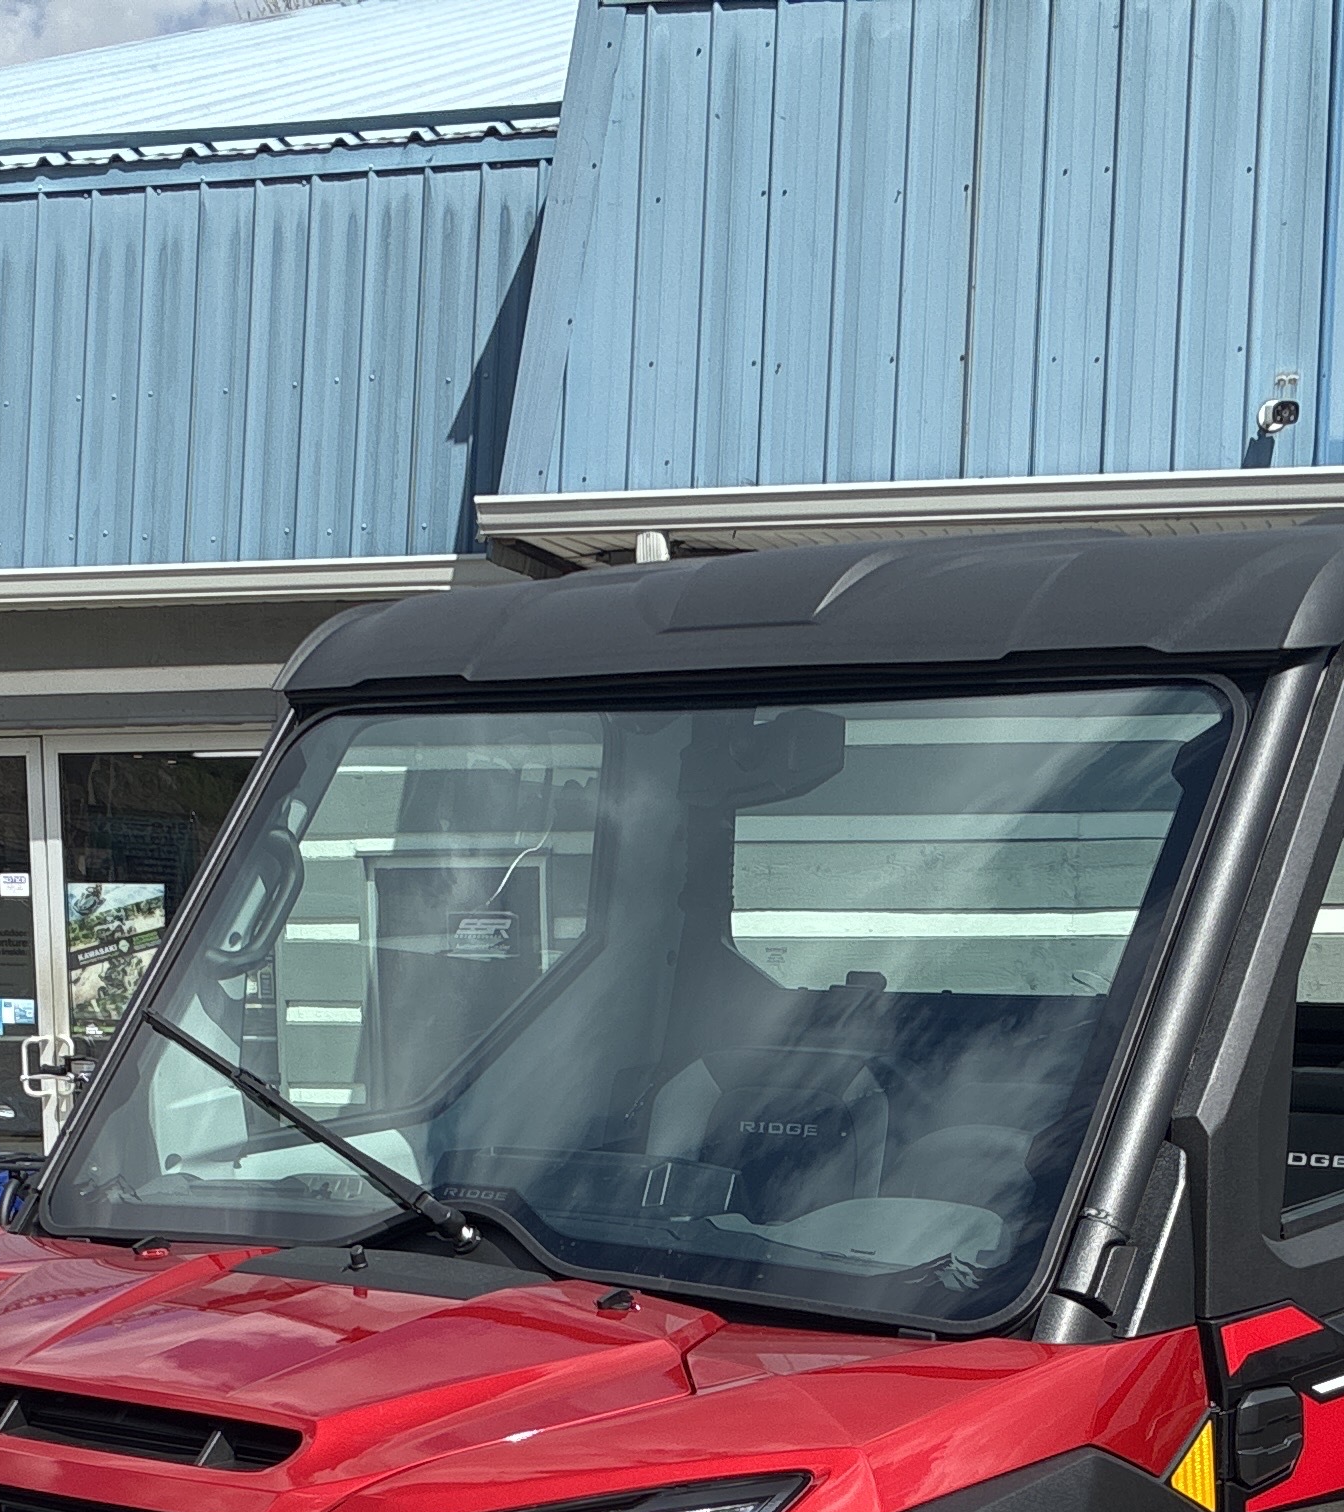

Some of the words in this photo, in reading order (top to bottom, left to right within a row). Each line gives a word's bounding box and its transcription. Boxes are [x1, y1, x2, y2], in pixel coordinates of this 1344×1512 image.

[455, 918, 512, 939] SSR
[739, 1121, 818, 1138] RIDGE
[443, 1187, 509, 1201] RIDGE
